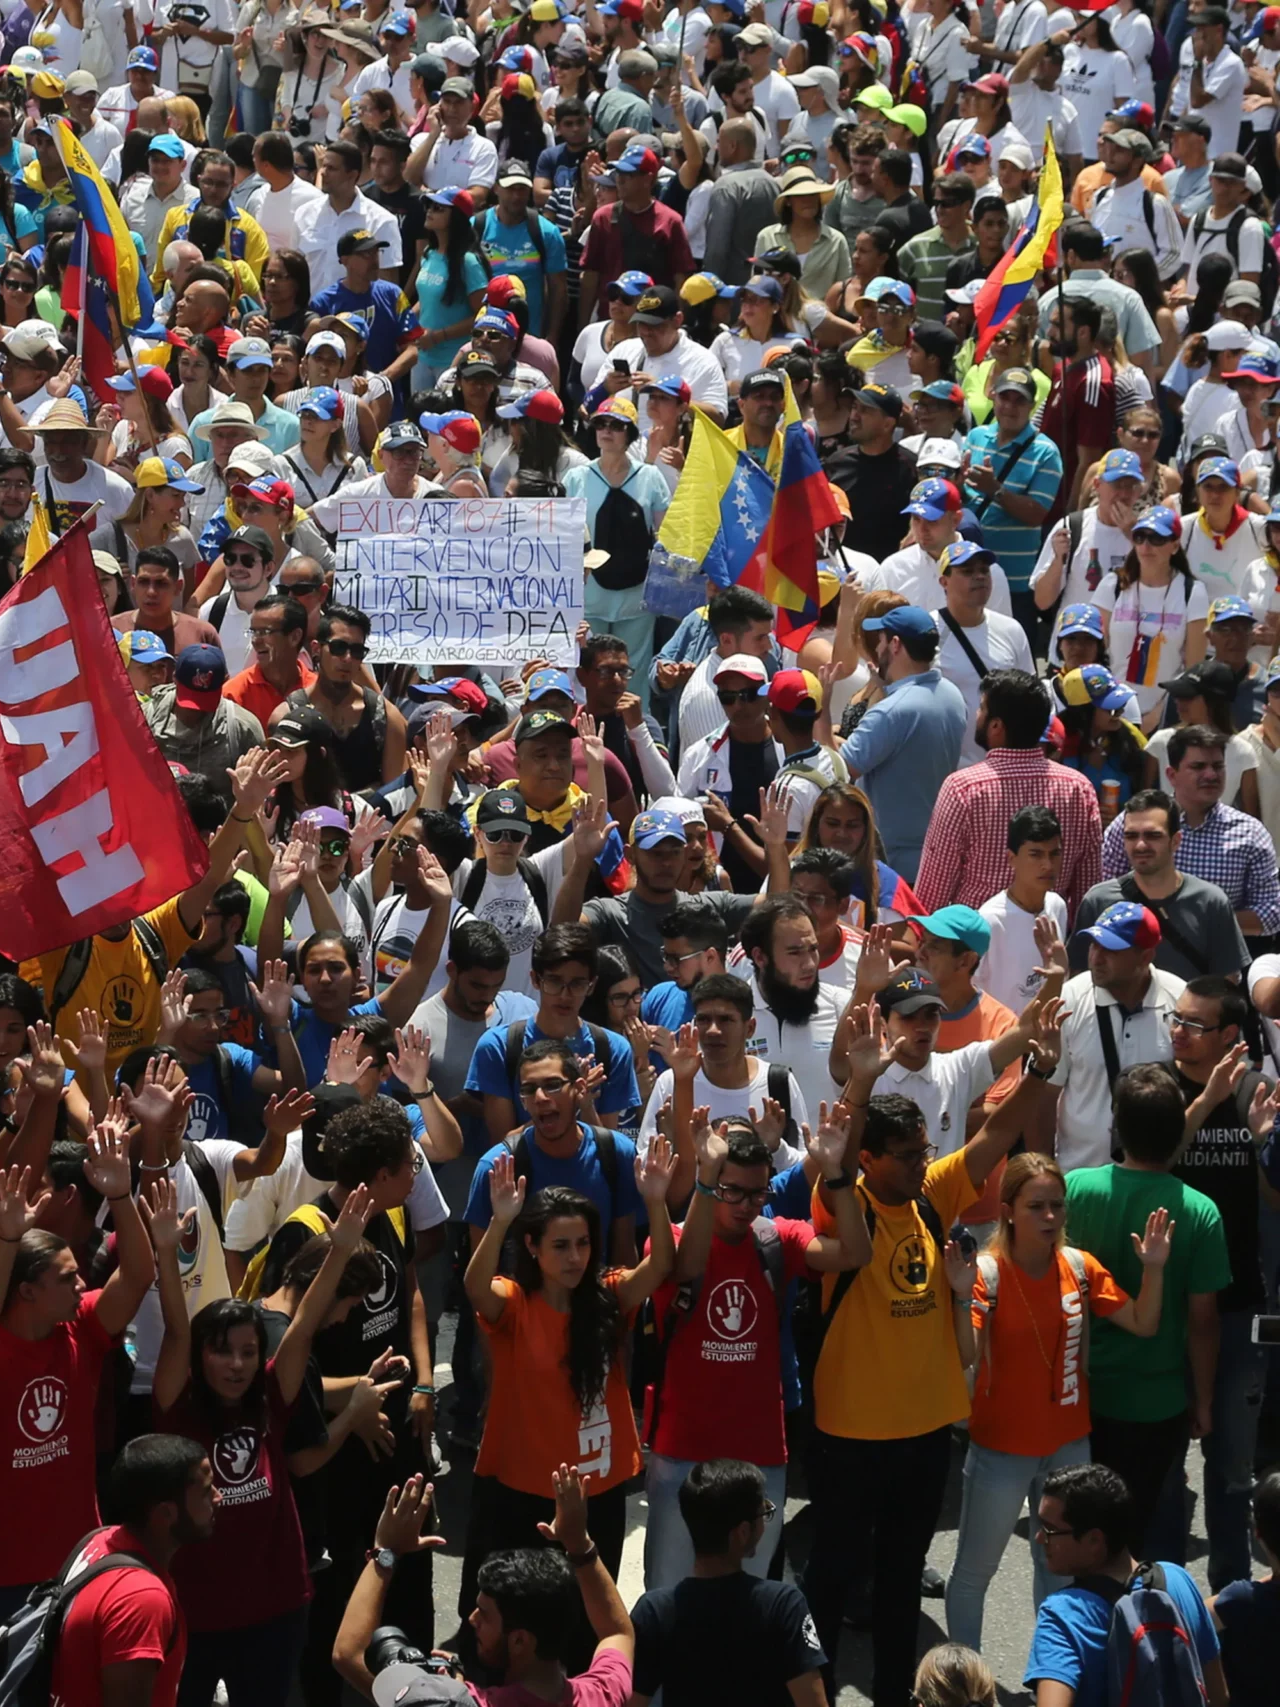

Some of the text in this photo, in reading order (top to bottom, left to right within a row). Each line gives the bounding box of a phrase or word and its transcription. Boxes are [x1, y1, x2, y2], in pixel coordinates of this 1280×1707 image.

[416, 501, 460, 535] ART
[407, 574, 582, 612] INTERNACIONAL
[367, 609, 572, 648] GRESO DE DEA
[366, 647, 421, 662] SACAR
[1196, 1127, 1252, 1143] IMIENTO
[1060, 1290, 1083, 1406] UNIMET
[13, 1434, 69, 1458] MOVIMIENO
[578, 1400, 611, 1478] MET
[12, 1446, 70, 1468] ESTUDIATIL
[218, 1476, 269, 1496] OVIMIENTO
[218, 1488, 272, 1506] TUDIANTIL
